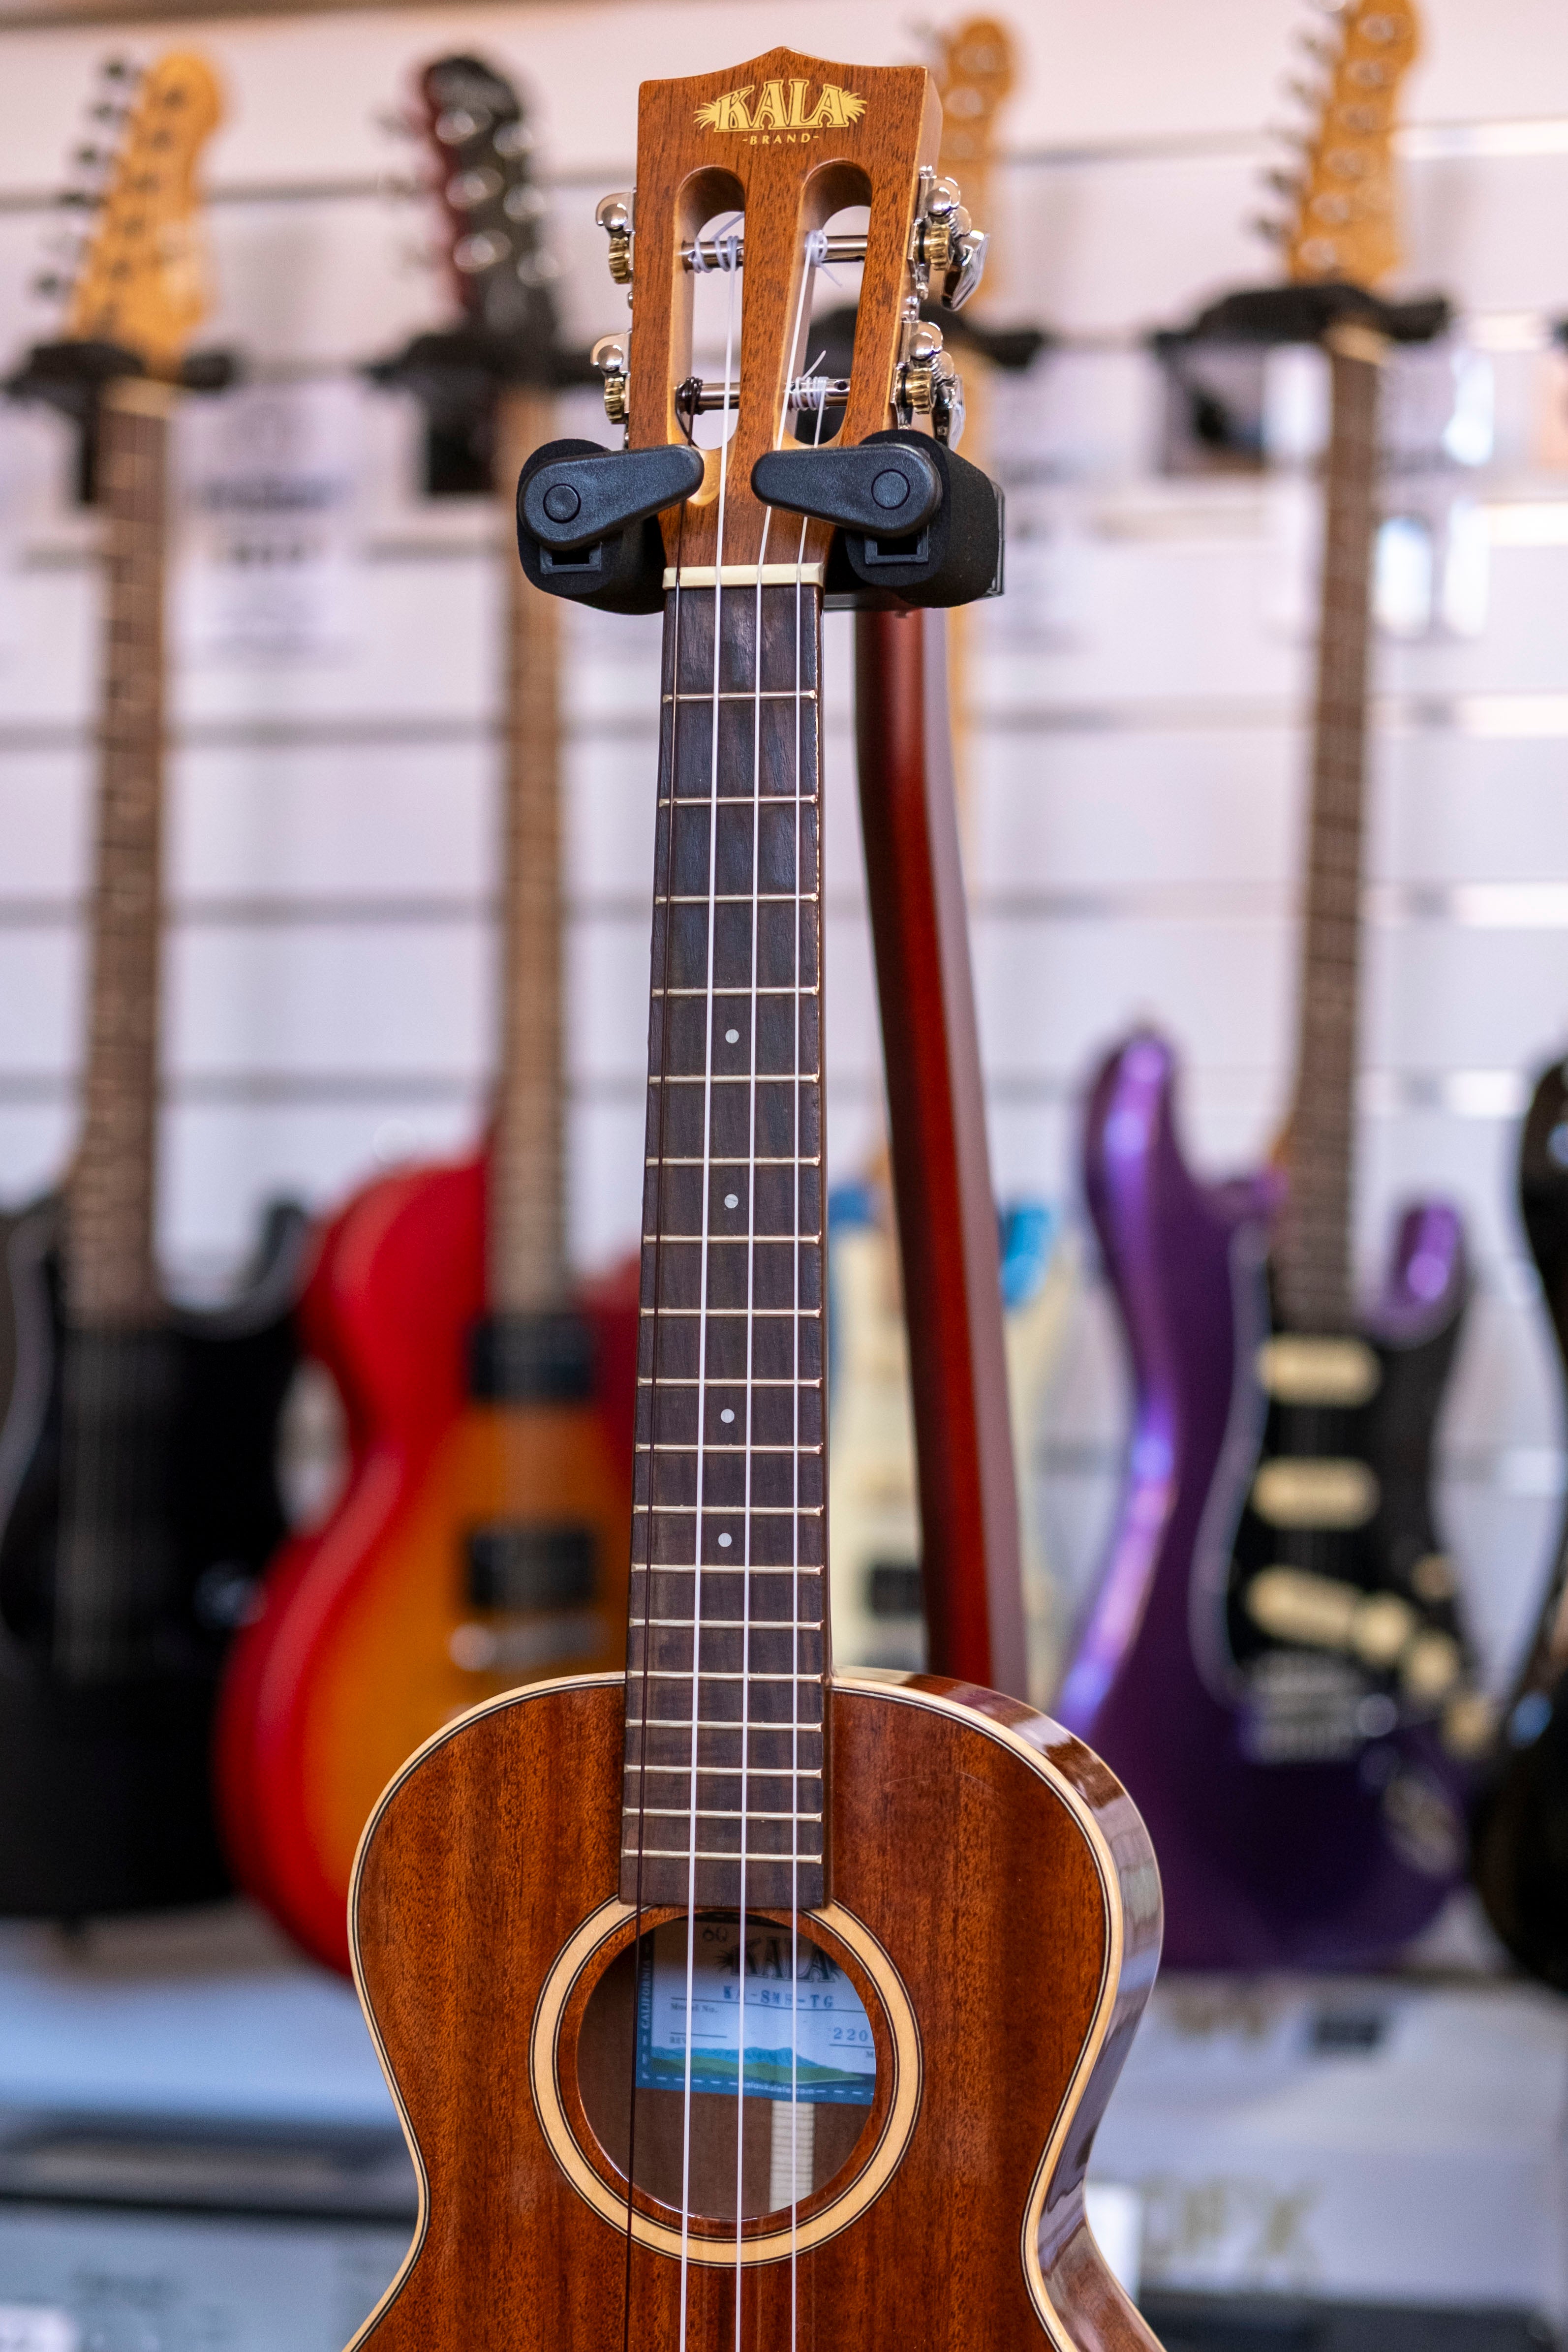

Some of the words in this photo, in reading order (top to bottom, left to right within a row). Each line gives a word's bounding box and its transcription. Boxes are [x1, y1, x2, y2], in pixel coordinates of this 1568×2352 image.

[714, 79, 849, 132] KALA
[731, 1936, 835, 1983] KALA
[641, 1960, 650, 2030] CALIFORNIA
[833, 2027, 873, 2042] 220
